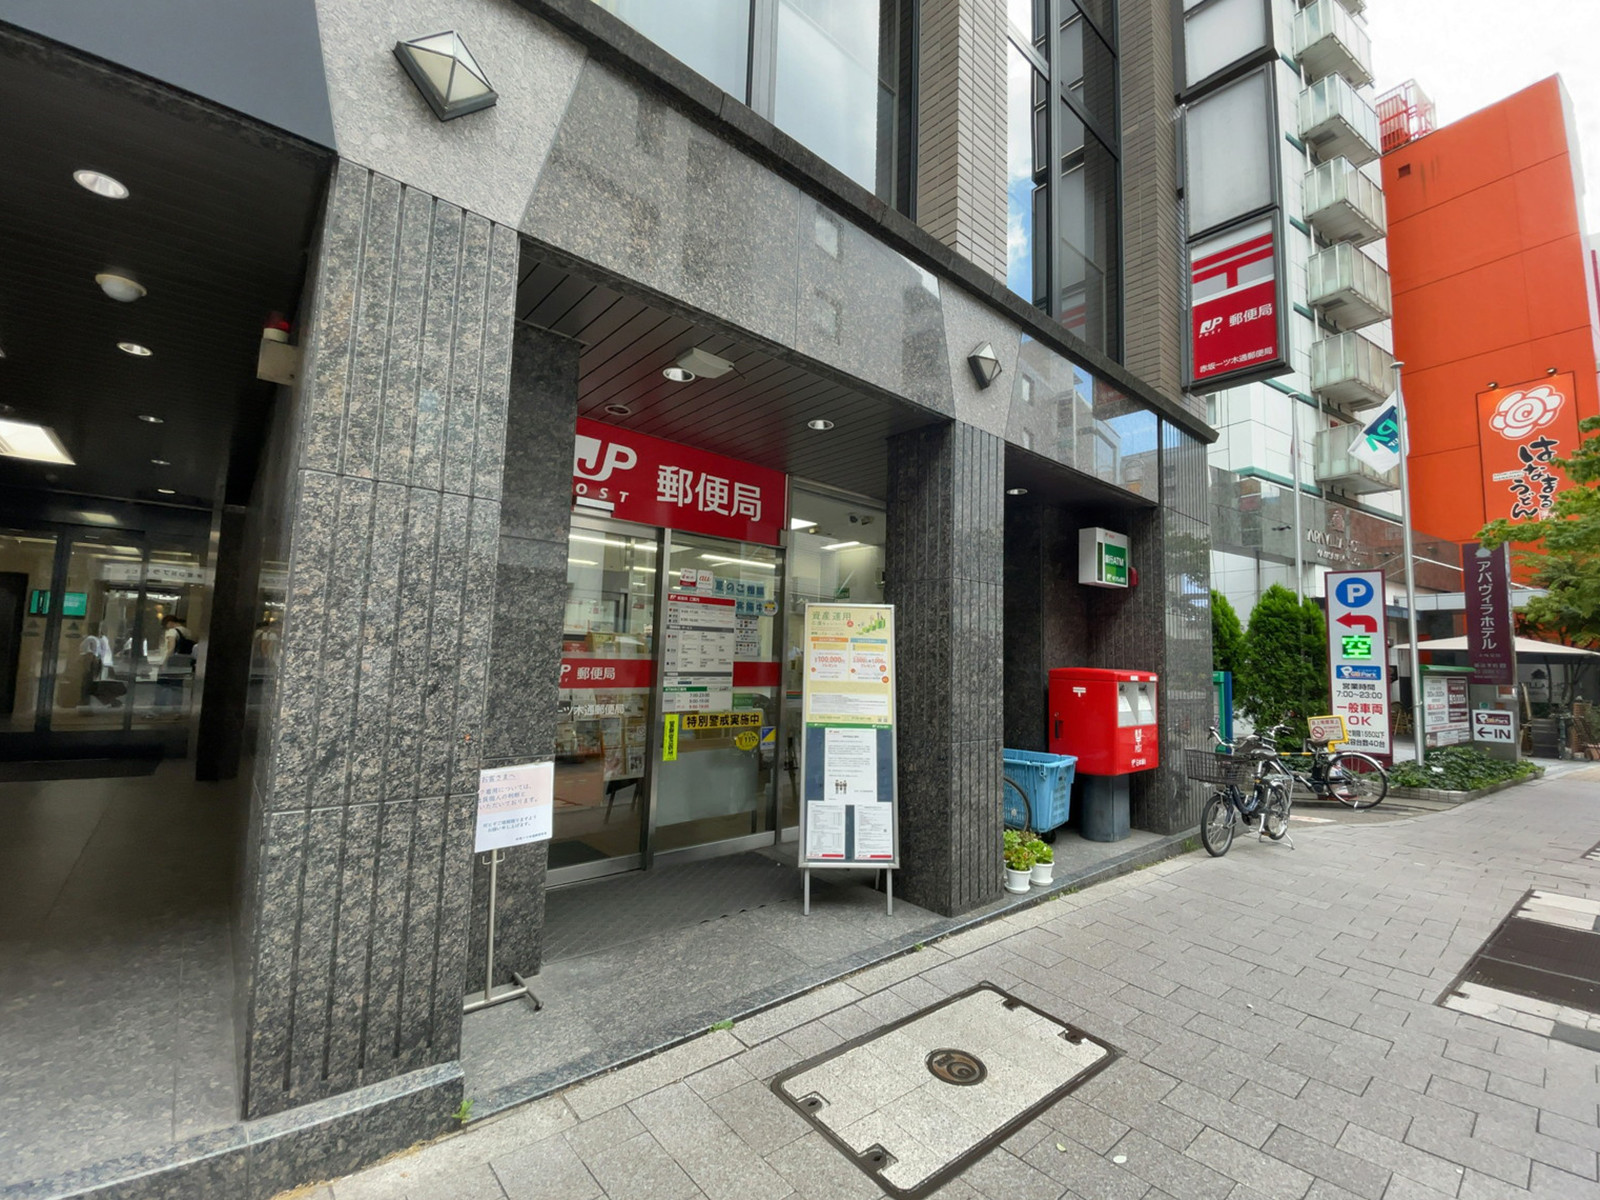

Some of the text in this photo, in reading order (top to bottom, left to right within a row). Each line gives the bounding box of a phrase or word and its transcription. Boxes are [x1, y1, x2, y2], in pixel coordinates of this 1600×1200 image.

[1229, 303, 1273, 327] 郵便局
[1199, 346, 1273, 373] 赤坂一ツ木通郵便局
[1518, 436, 1559, 509] はなまる
[575, 483, 629, 503] OST
[657, 465, 762, 522] 郵便局
[1509, 478, 1538, 519] うどん
[1346, 584, 1366, 603] P
[1342, 634, 1372, 660] 空
[576, 666, 616, 681] 郵便局
[1342, 682, 1375, 691] 営業時間
[557, 703, 625, 716] 一ツ木通郵便局
[1336, 702, 1384, 715] 一般車両
[686, 713, 760, 728] 特別警戒実施中
[1348, 715, 1372, 726] OK
[1494, 728, 1511, 739] IN
